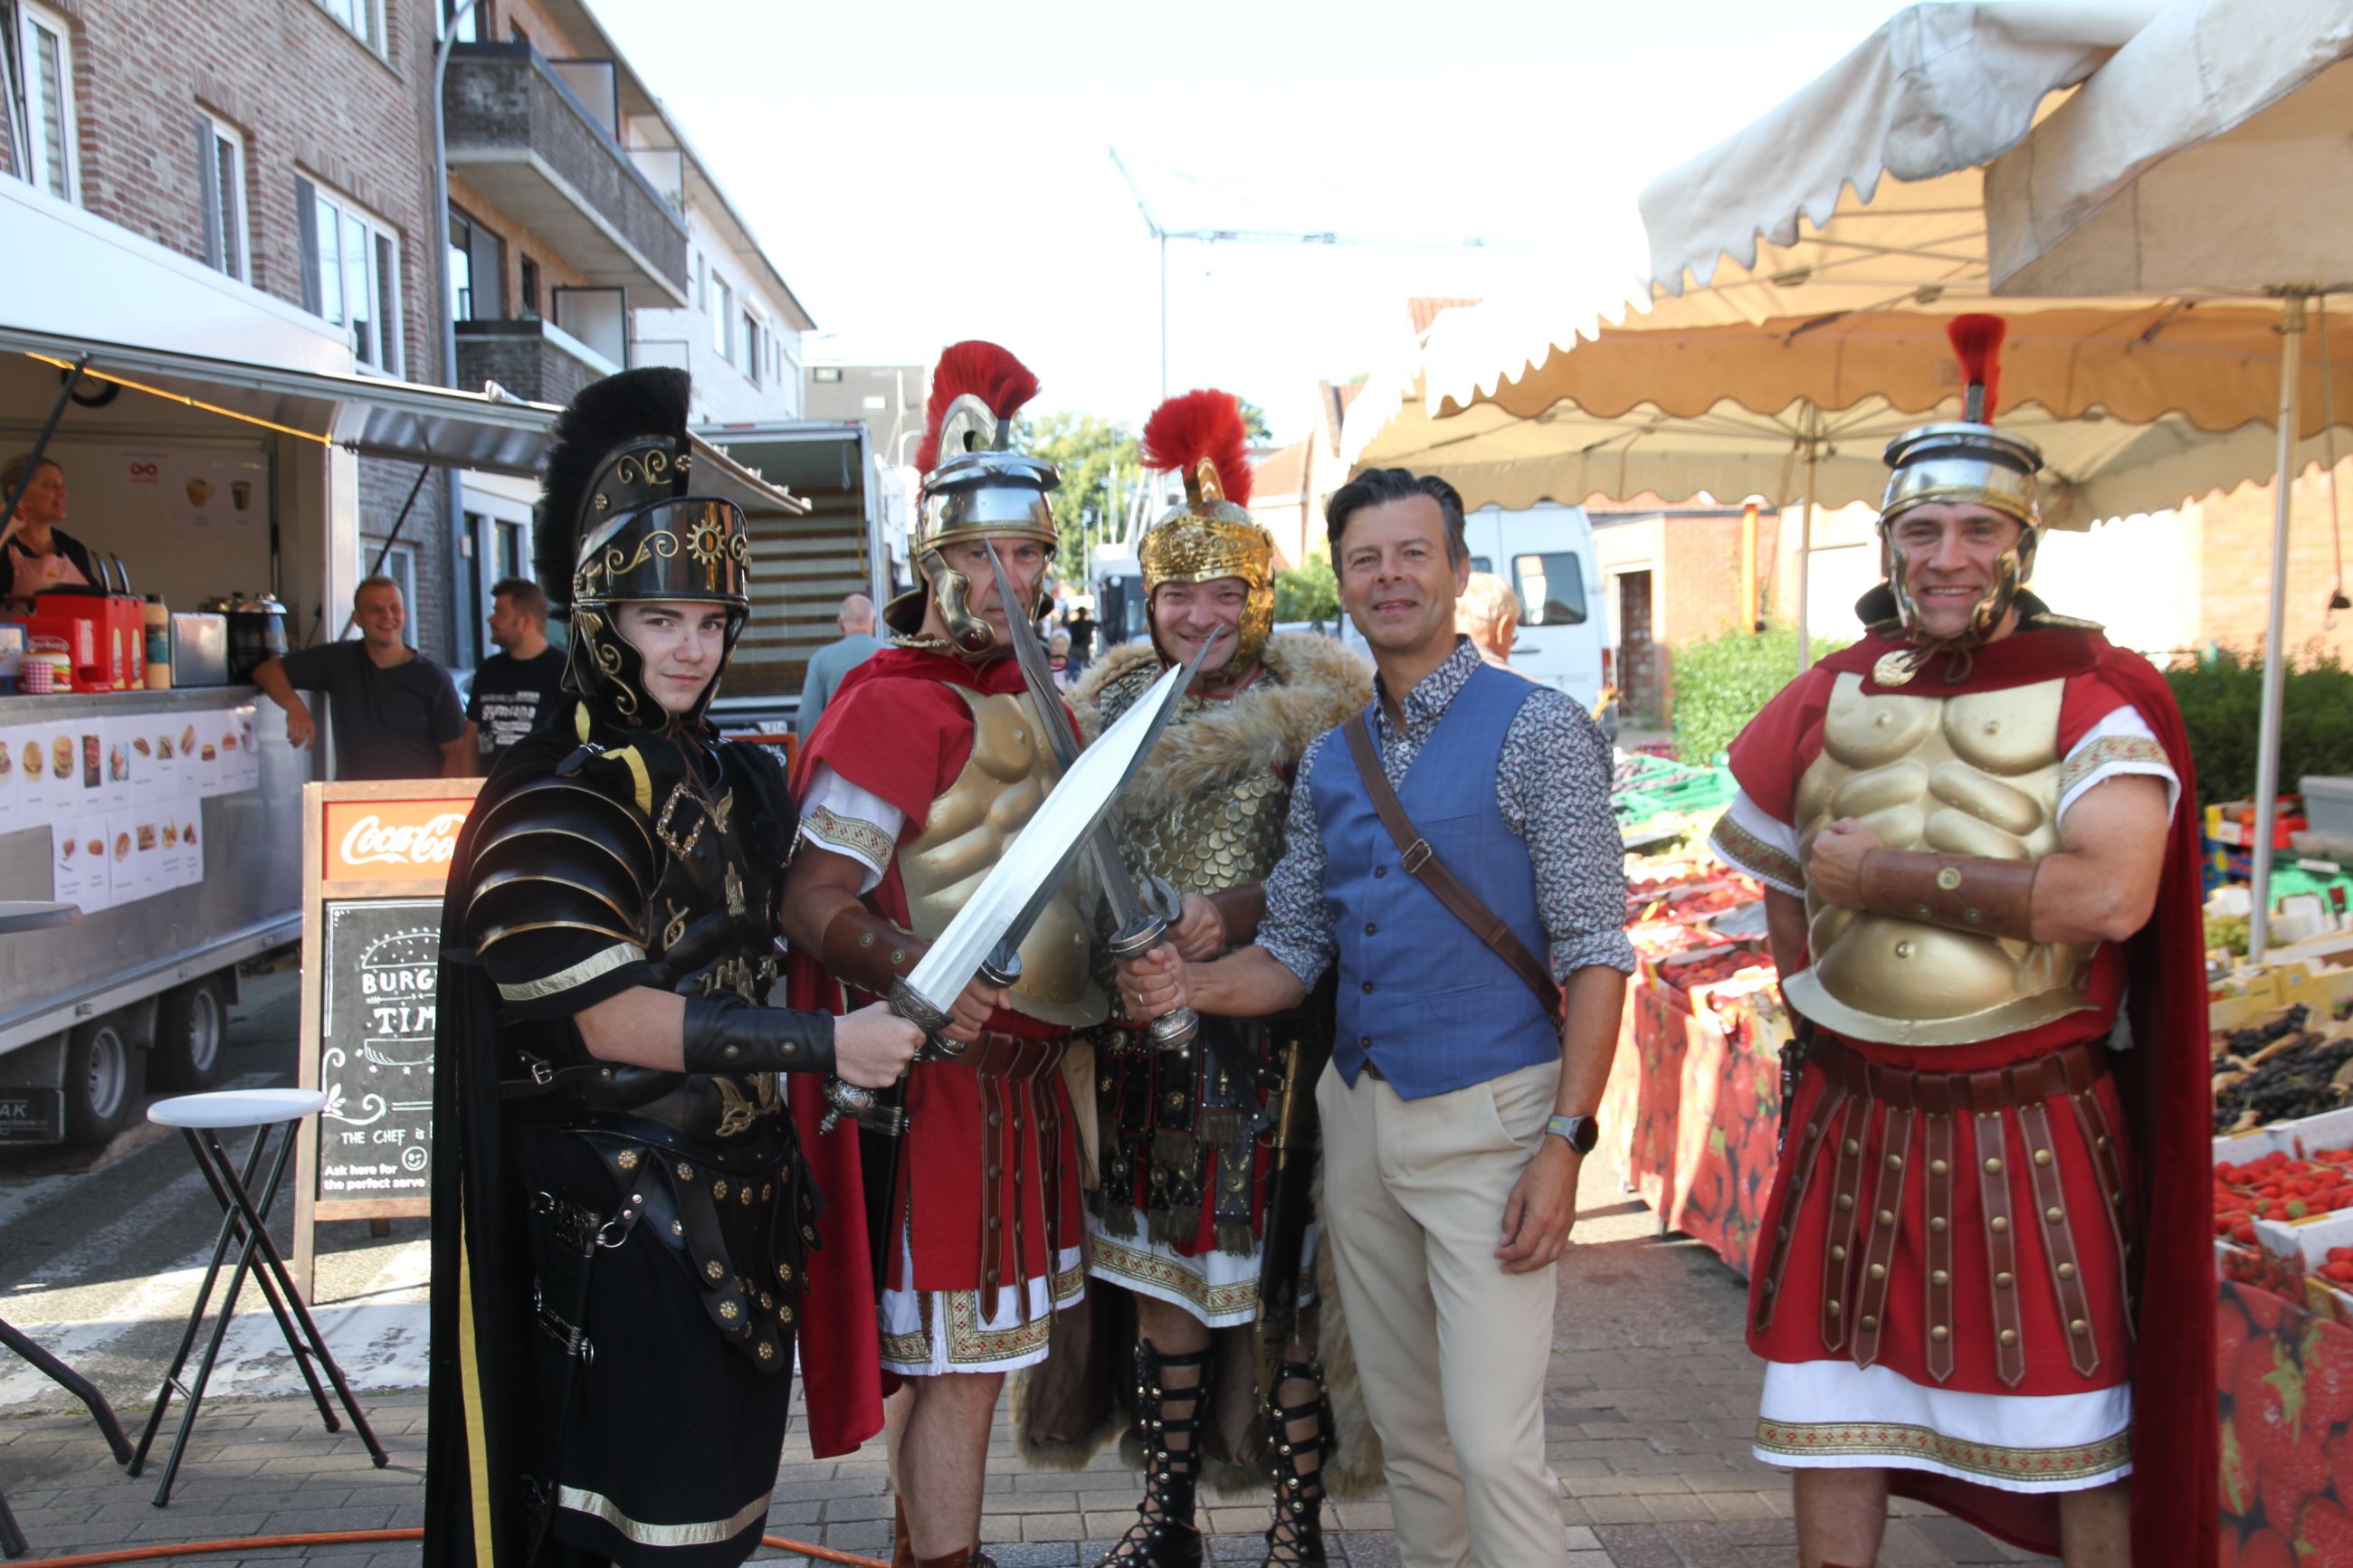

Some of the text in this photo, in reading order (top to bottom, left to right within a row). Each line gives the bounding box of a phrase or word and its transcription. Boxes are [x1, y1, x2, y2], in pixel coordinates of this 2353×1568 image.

[340, 813, 467, 865] Coca-Co
[362, 968, 438, 994] BURG
[373, 1005, 436, 1034] TIM
[0, 1104, 27, 1117] AK
[340, 1131, 366, 1145] THE
[373, 1129, 406, 1146] CHEF
[324, 1163, 398, 1176] Ask here for
[324, 1178, 426, 1191] the perfect serve
